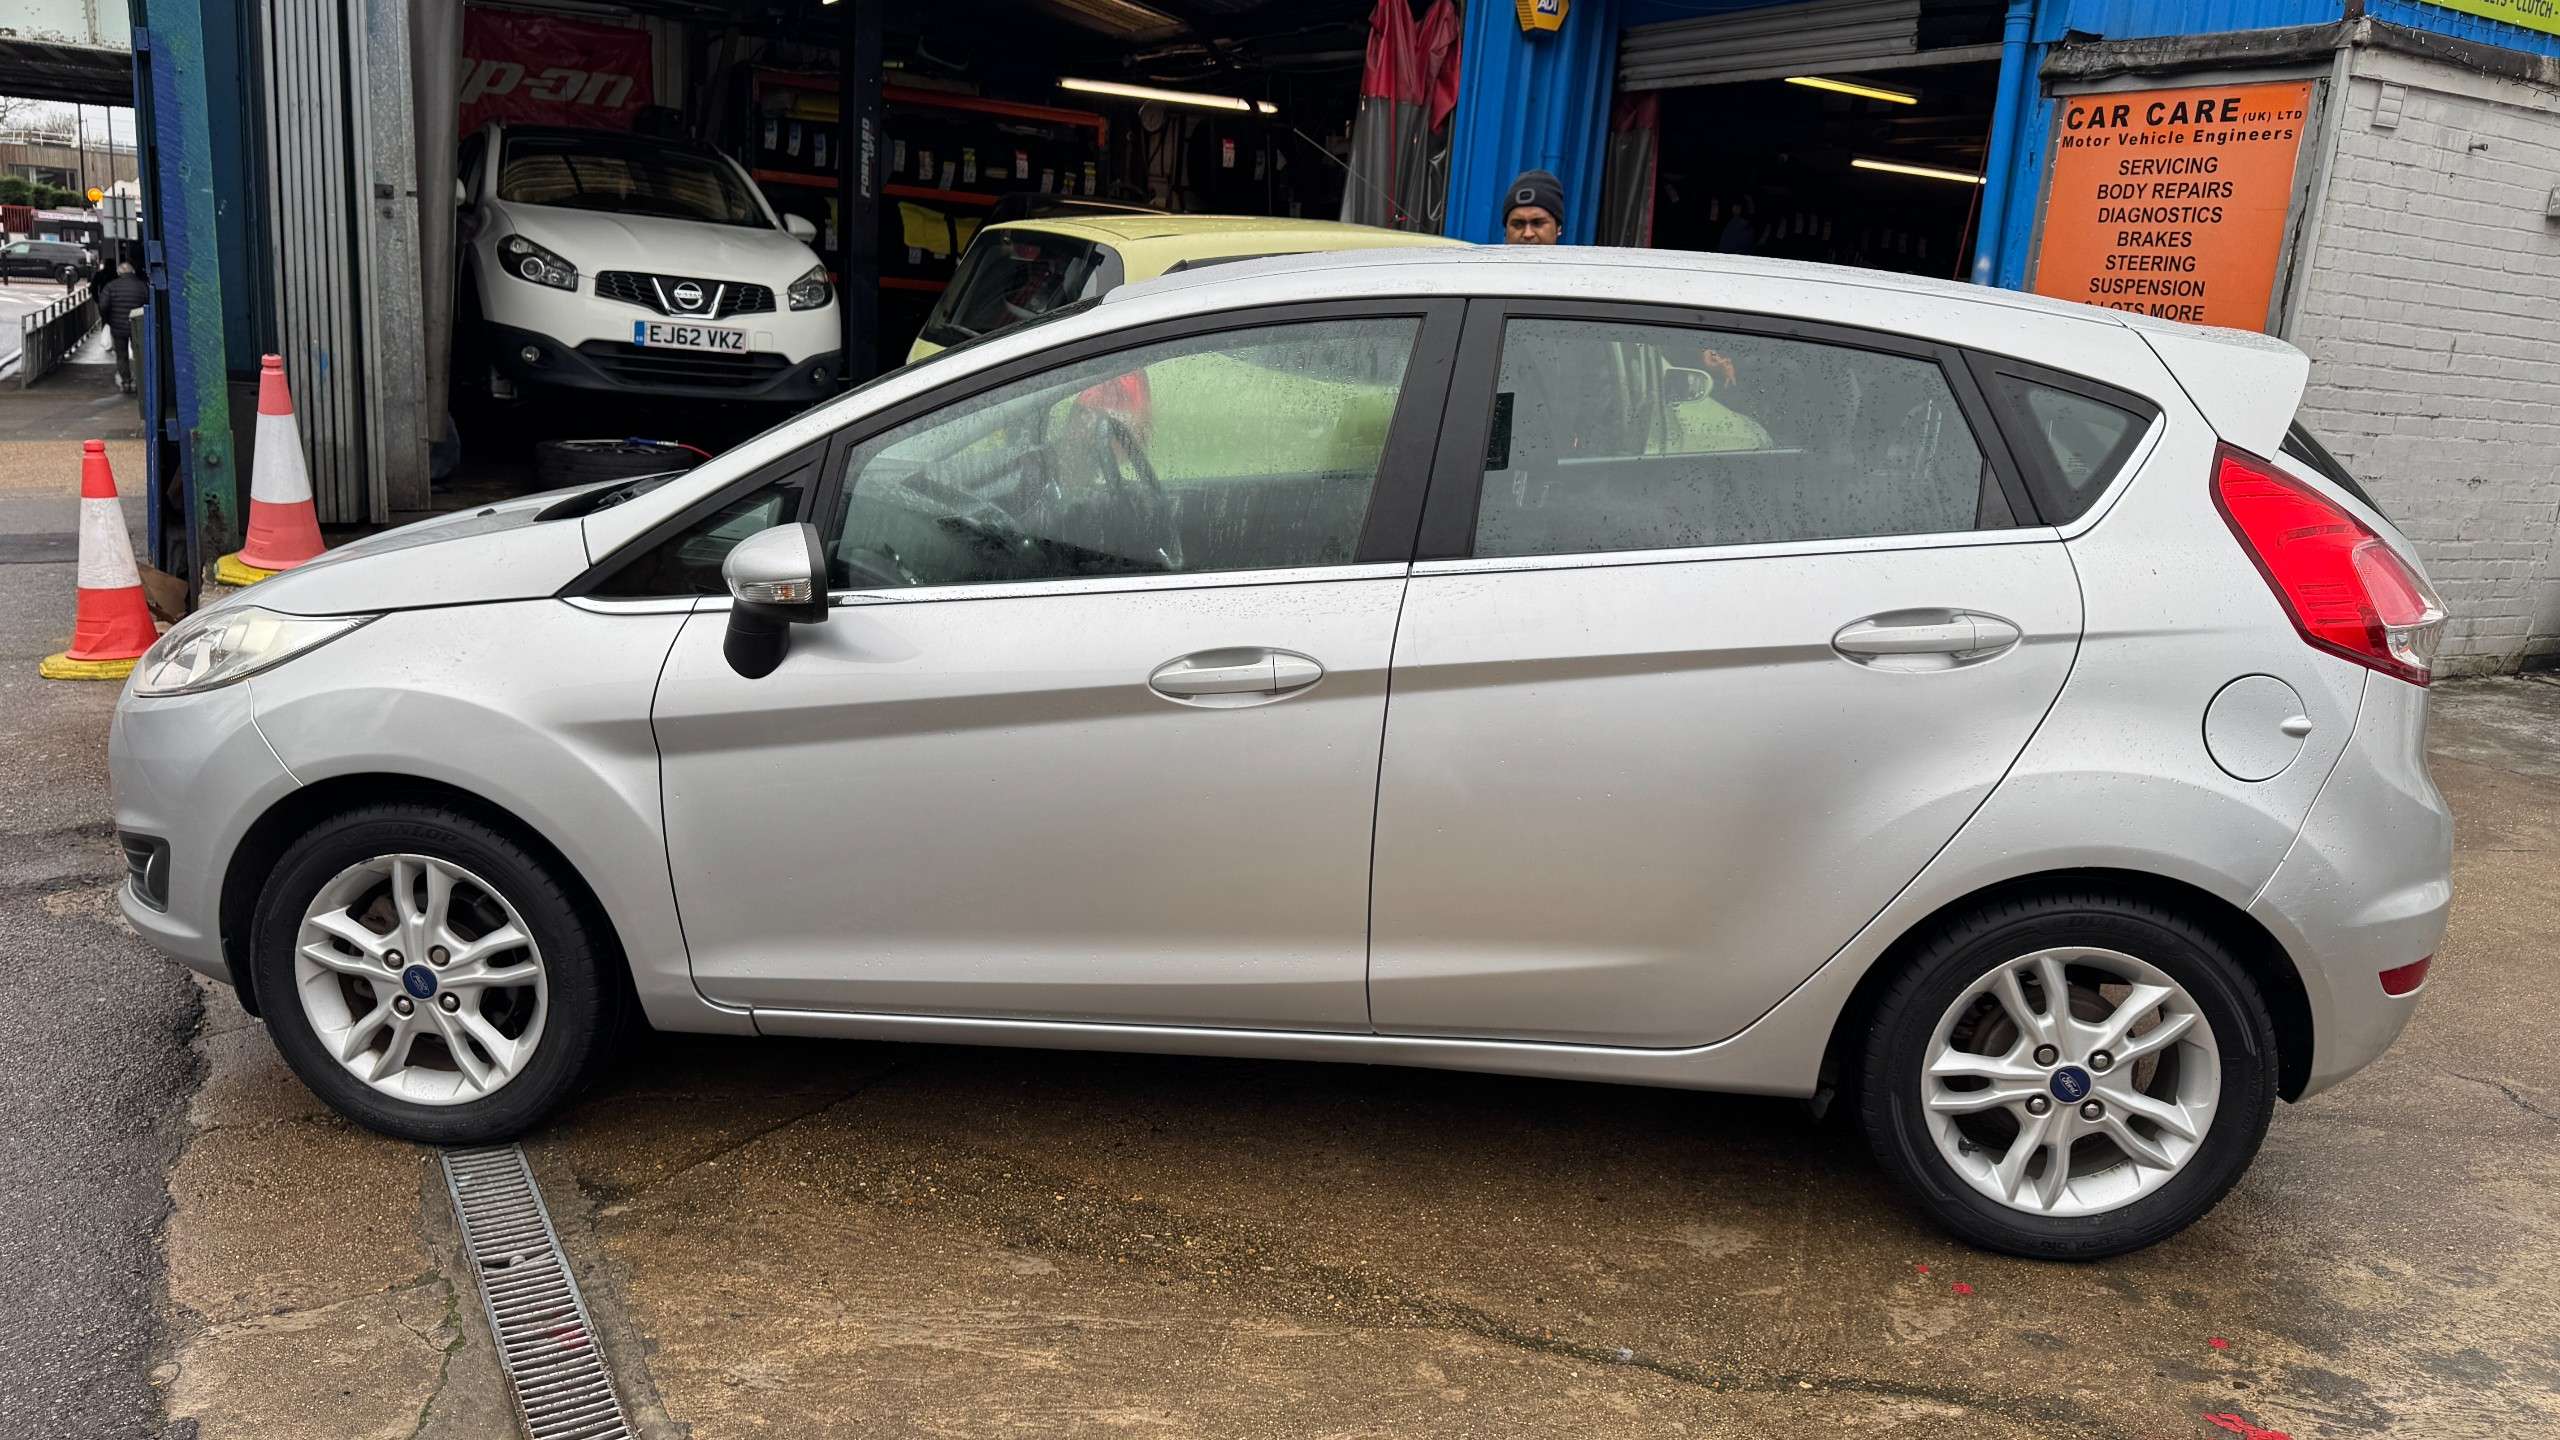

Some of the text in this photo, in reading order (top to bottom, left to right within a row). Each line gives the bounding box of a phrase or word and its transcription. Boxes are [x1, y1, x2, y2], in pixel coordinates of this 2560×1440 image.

[2516, 0, 2554, 18] CLUTCH
[2066, 97, 2303, 130] CAR CARE (UK) LTD
[2061, 128, 2294, 149] Motor Vehicle Engineers
[2118, 157, 2219, 176] SERVICING
[2096, 181, 2233, 200] BODY REPAIRS
[2097, 206, 2223, 224] DIAGNOSTICS
[2116, 231, 2193, 248] BRAKES
[2105, 254, 2197, 273] STEERING
[2088, 277, 2206, 297] SUSPENSION
[2149, 303, 2206, 322] MORE
[650, 325, 744, 350] EJ62 VKZ
